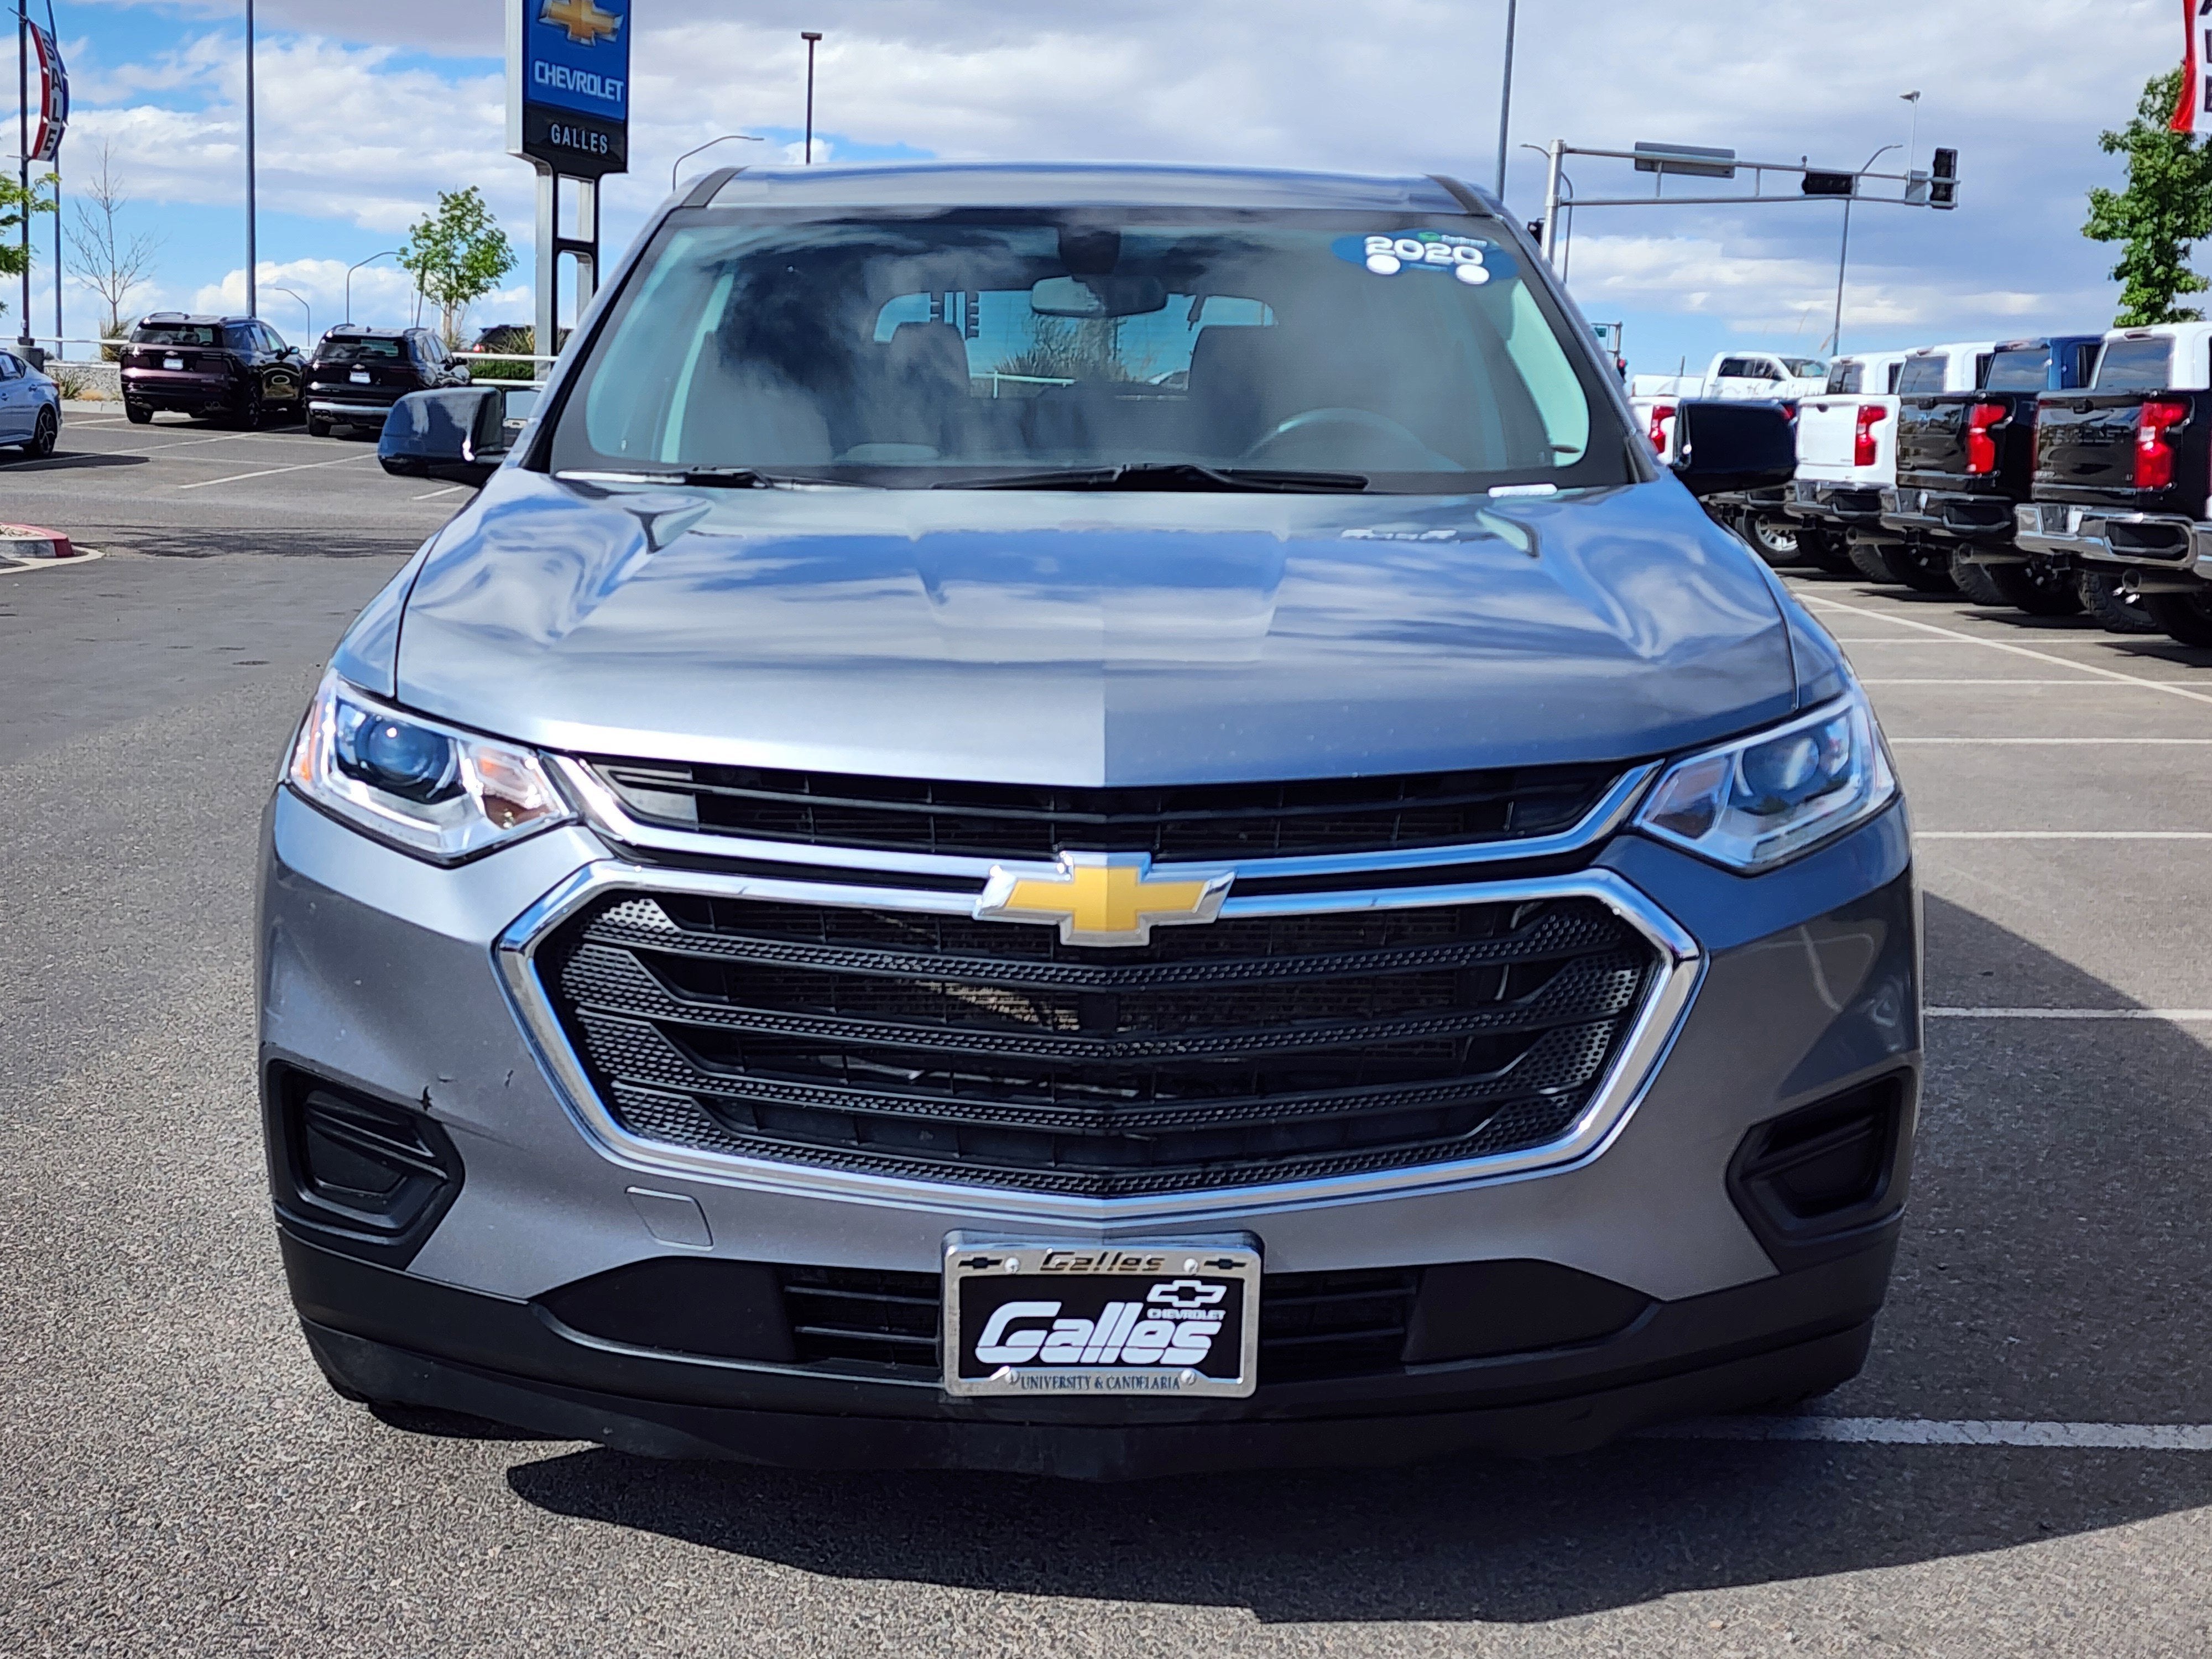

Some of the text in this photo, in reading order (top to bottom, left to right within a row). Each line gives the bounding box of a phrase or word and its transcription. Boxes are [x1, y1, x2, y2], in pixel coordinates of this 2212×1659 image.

[42, 38, 64, 152] SALE
[534, 61, 624, 102] CHEVROLET
[551, 123, 608, 154] GALLES
[1364, 236, 1484, 265] 2020
[1040, 1251, 1166, 1271] Galles
[1147, 1308, 1226, 1321] CHEVROLET
[975, 1301, 1222, 1365] Galles
[1020, 1375, 1181, 1390] UNIVERSITY & CANDELARIA
